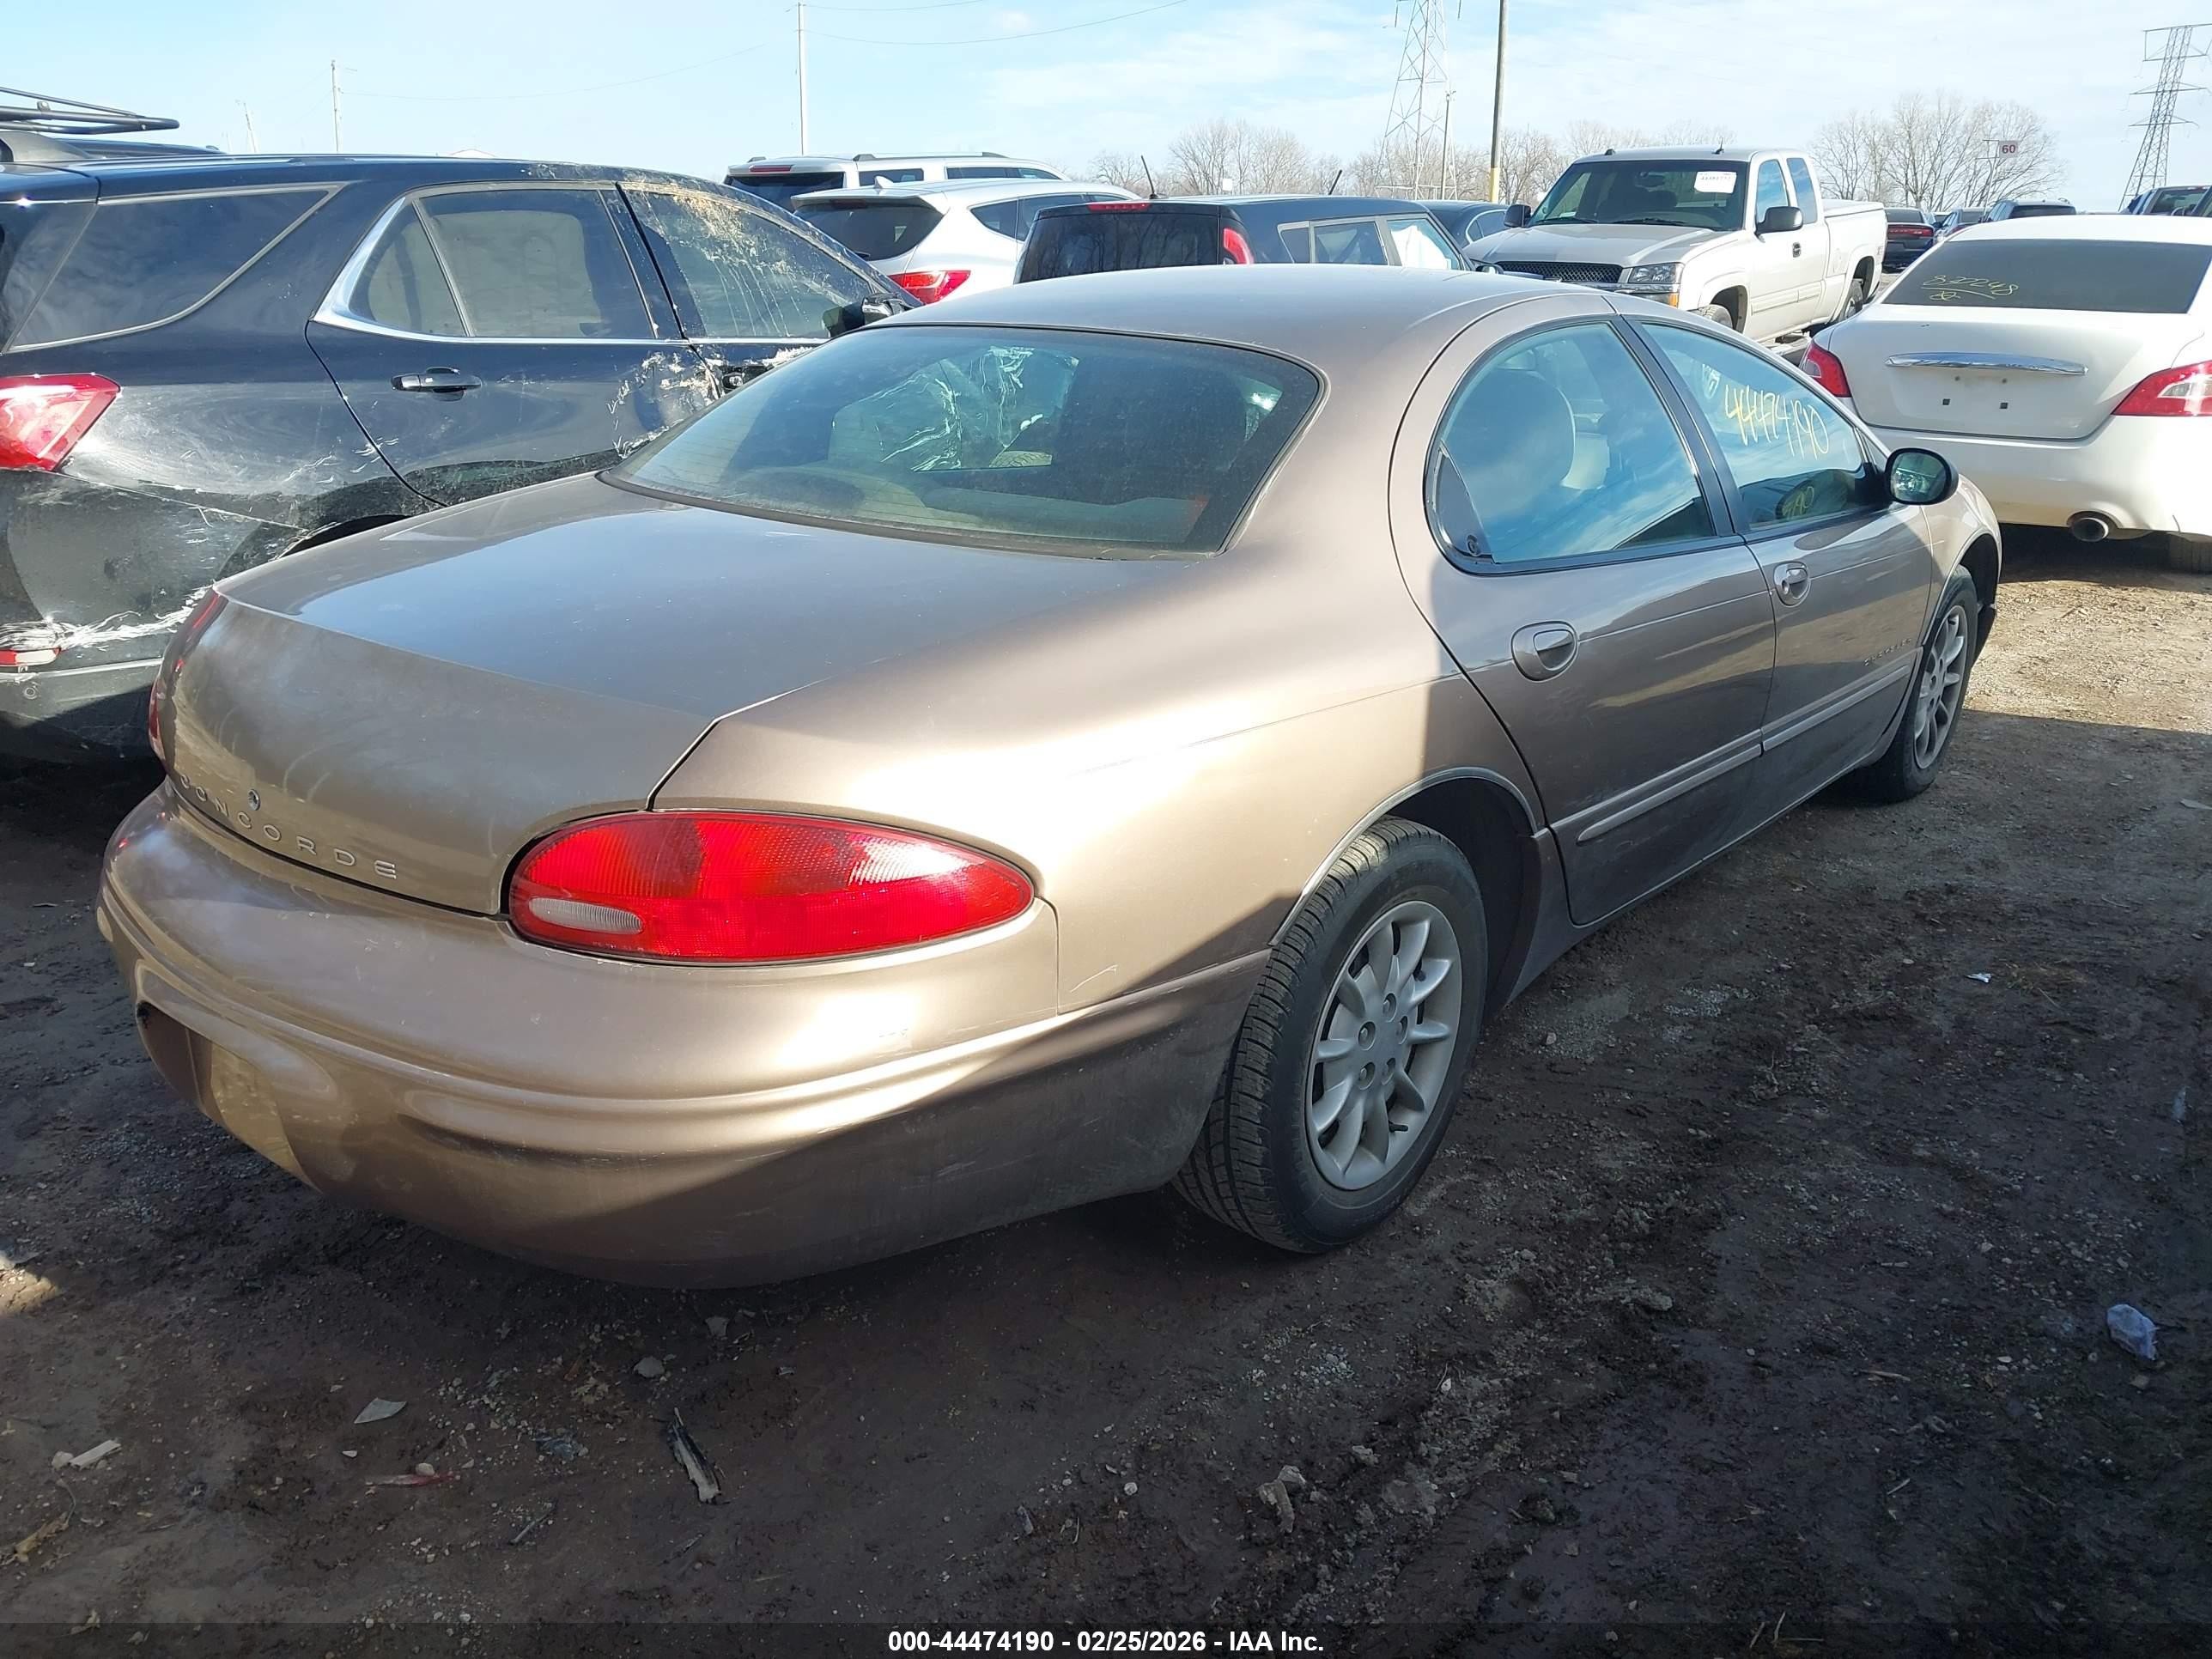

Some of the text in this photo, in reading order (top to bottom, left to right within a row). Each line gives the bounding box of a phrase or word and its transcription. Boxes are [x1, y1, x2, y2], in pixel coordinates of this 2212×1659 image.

[2002, 144, 2016, 154] 60
[1724, 384, 1829, 460] 44474190
[179, 774, 397, 879] CONCORDE
